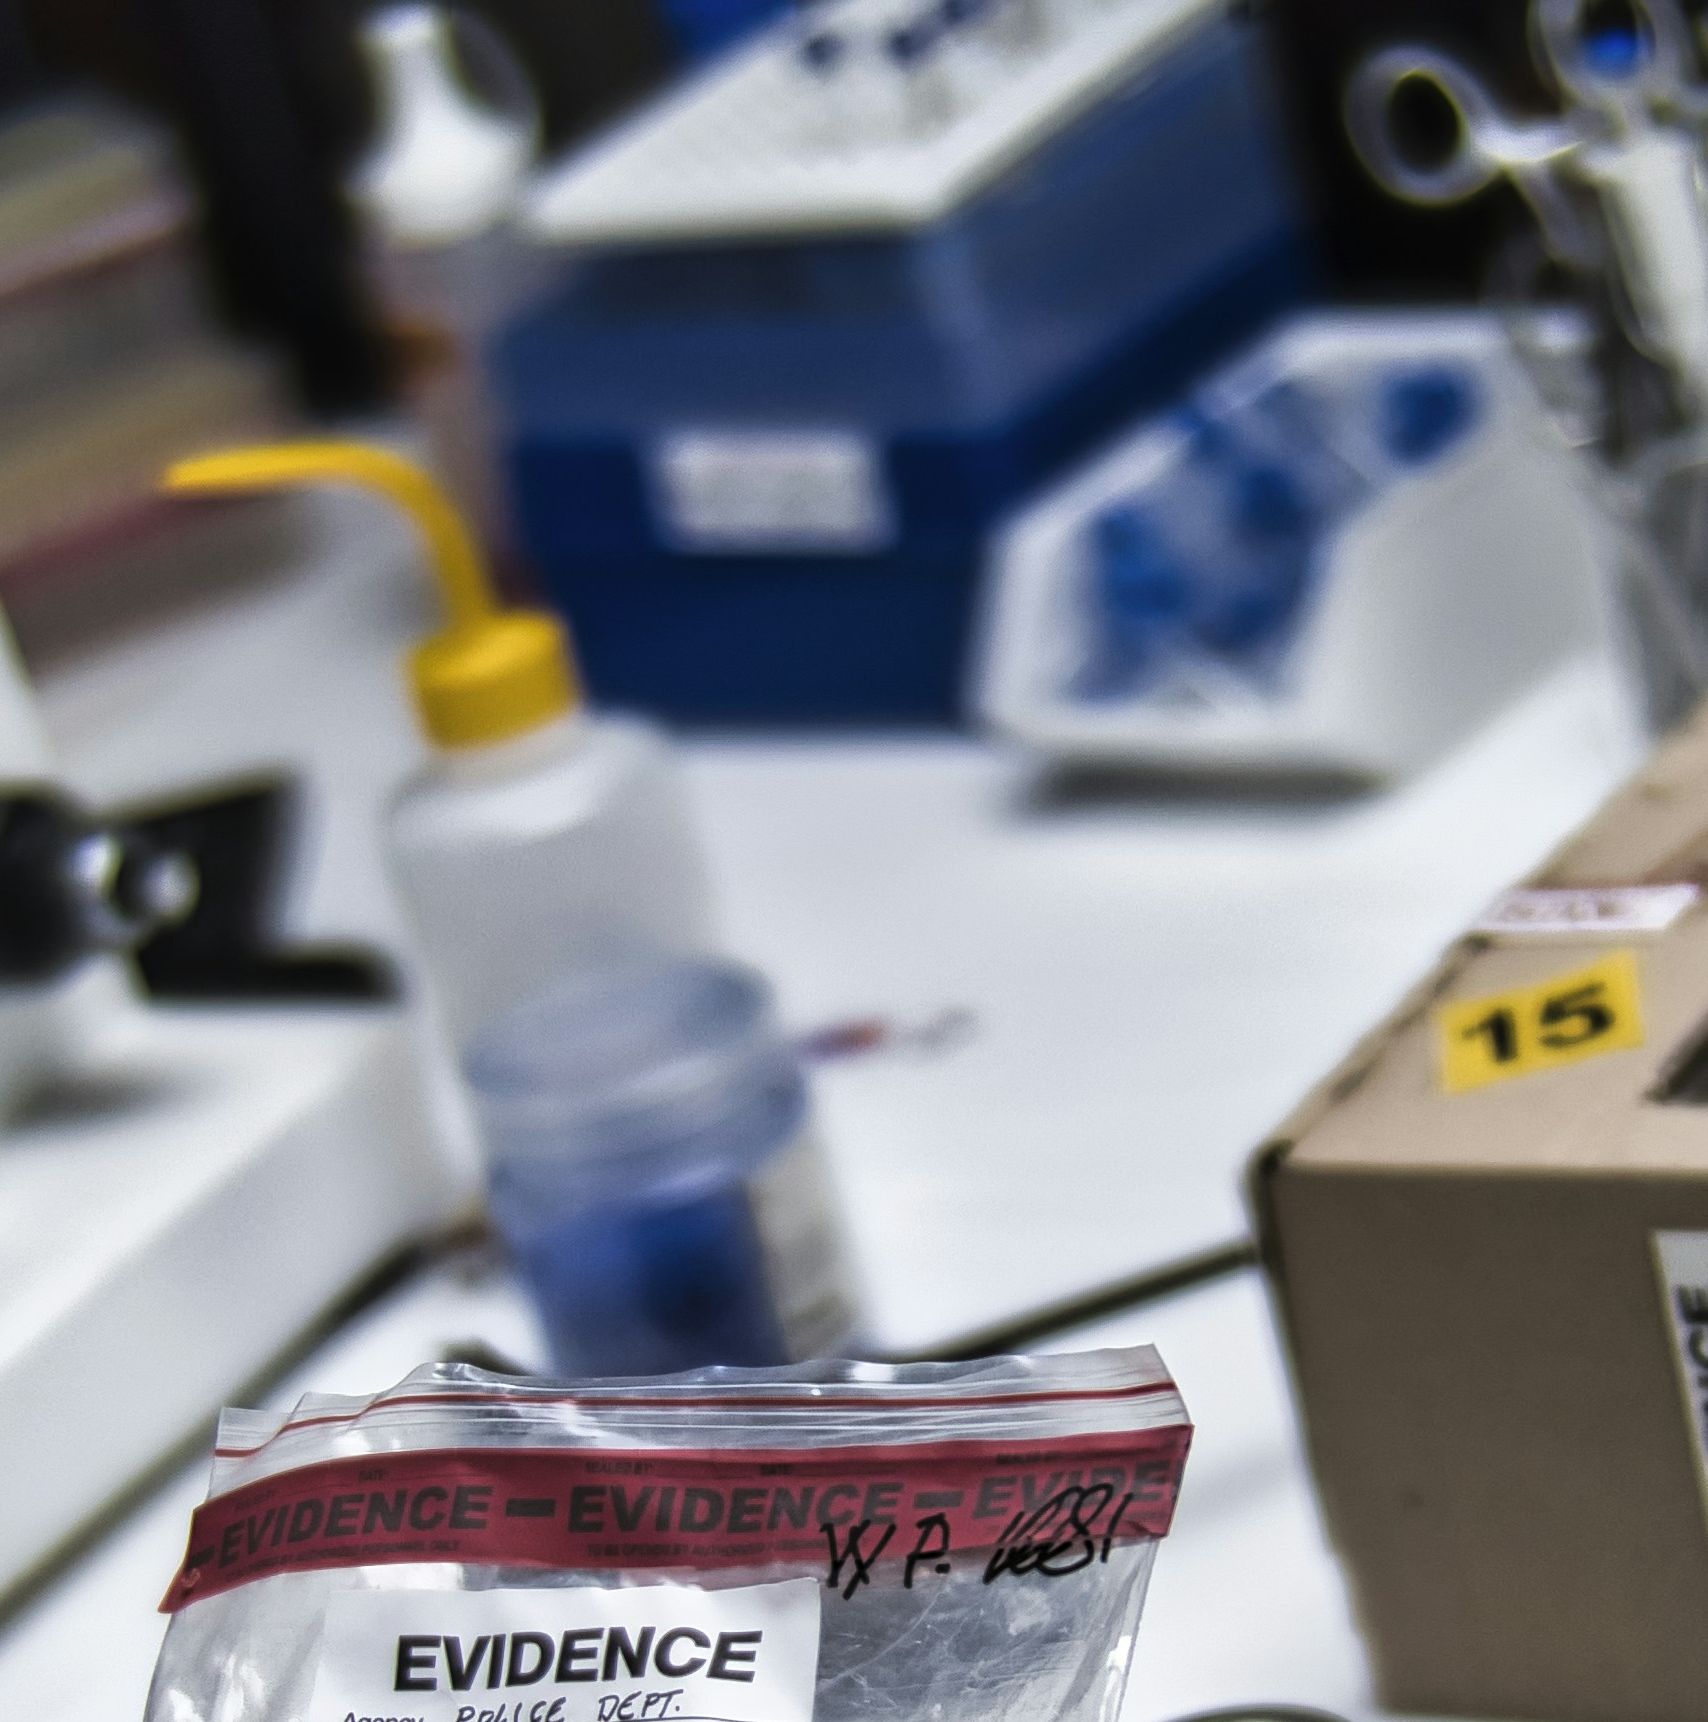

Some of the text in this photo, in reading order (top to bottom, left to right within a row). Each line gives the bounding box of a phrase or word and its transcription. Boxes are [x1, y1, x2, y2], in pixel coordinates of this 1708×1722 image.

[1461, 980, 1616, 1064] 15
[218, 1460, 1179, 1569] EVIDENCE EVIDENCE EVIDE
[394, 1627, 762, 1692] EVIDENCE
[597, 1690, 682, 1722] DEPT.
